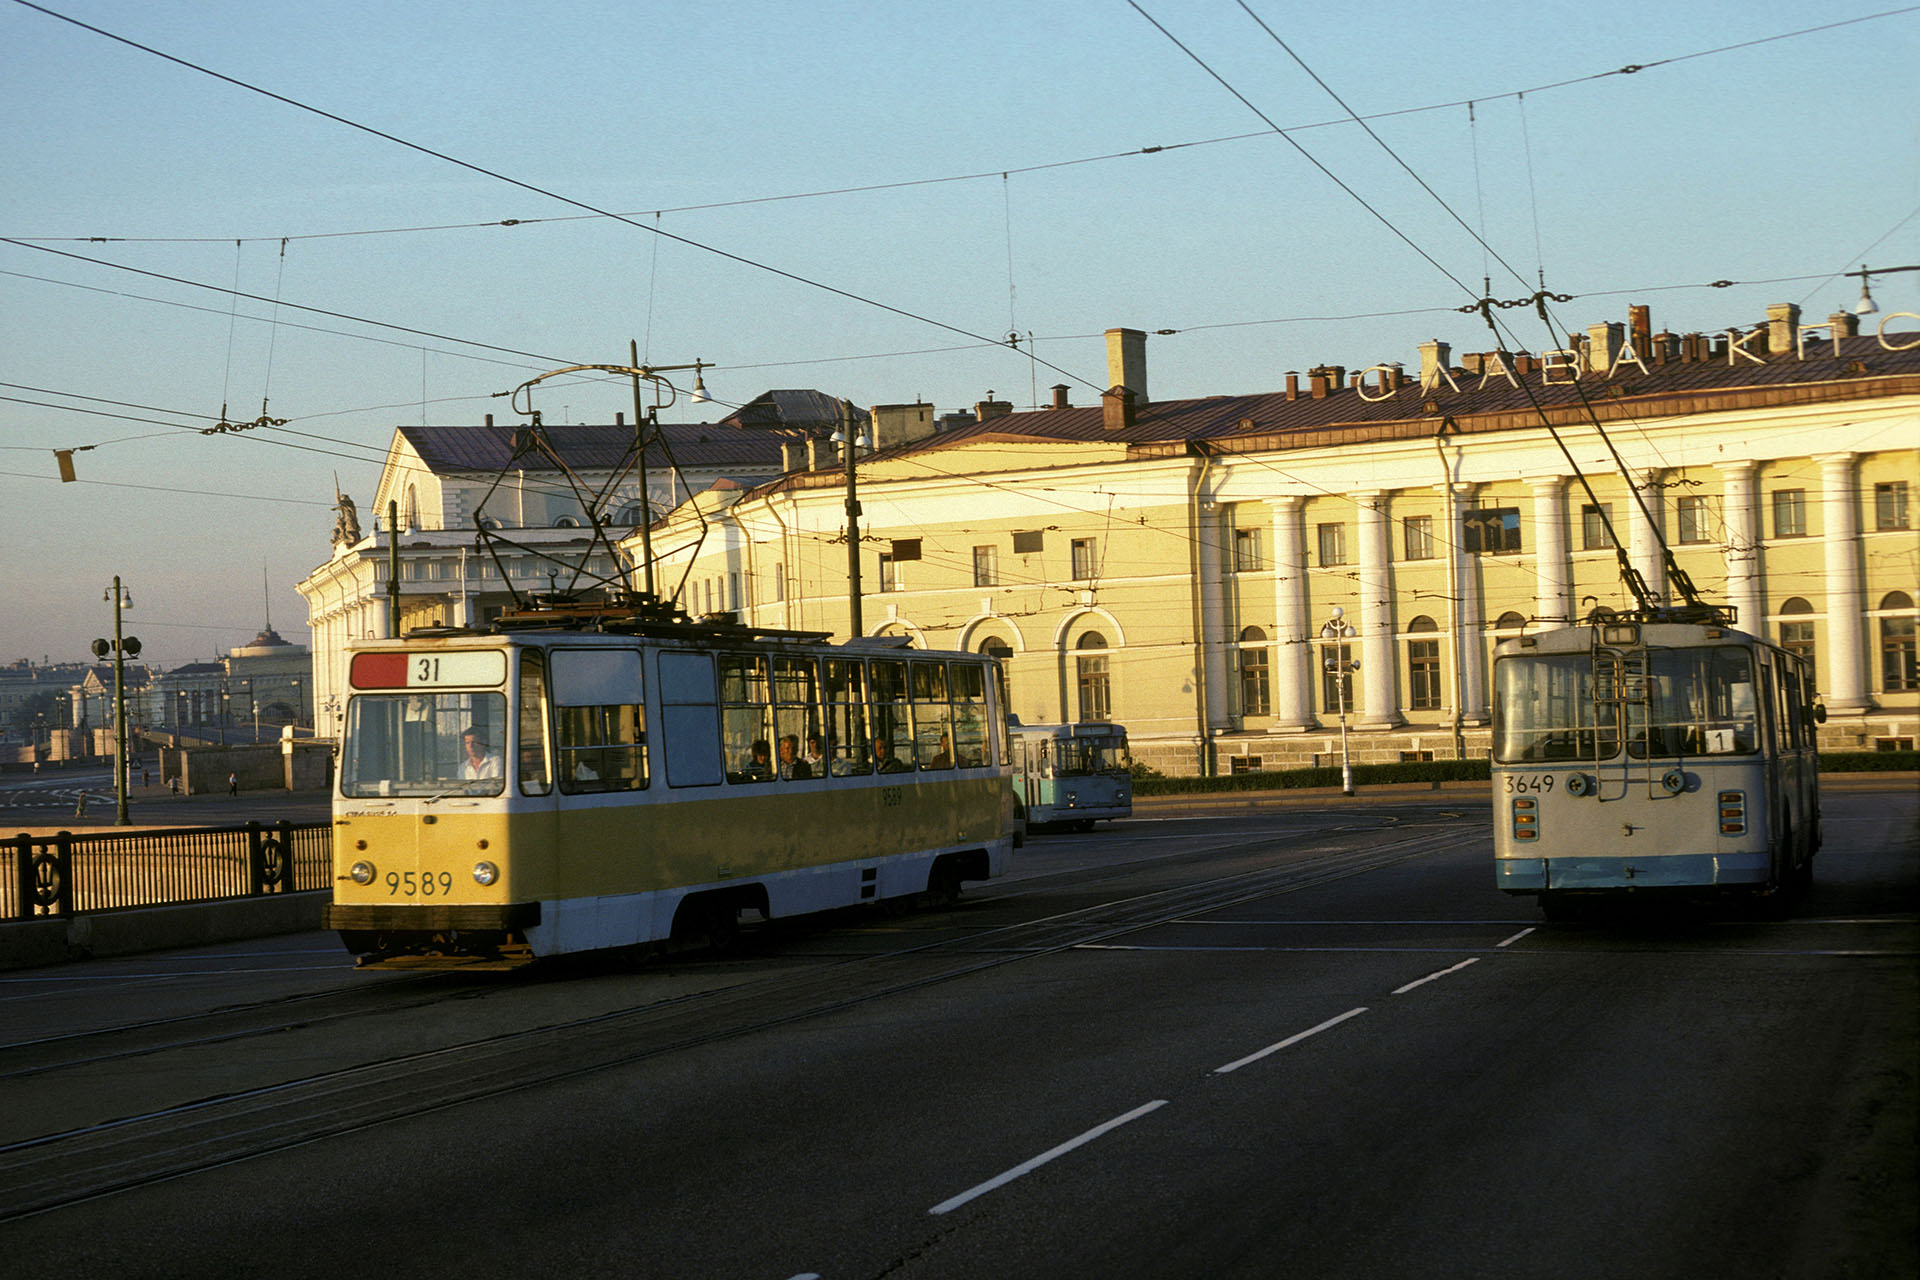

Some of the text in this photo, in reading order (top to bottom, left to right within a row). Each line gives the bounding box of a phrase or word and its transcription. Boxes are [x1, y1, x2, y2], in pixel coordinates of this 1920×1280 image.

[1357, 340, 1650, 402] СЛАВА
[417, 658, 440, 682] 31
[1714, 731, 1724, 751] 1
[1503, 774, 1554, 794] 3649
[385, 871, 452, 896] 9589
